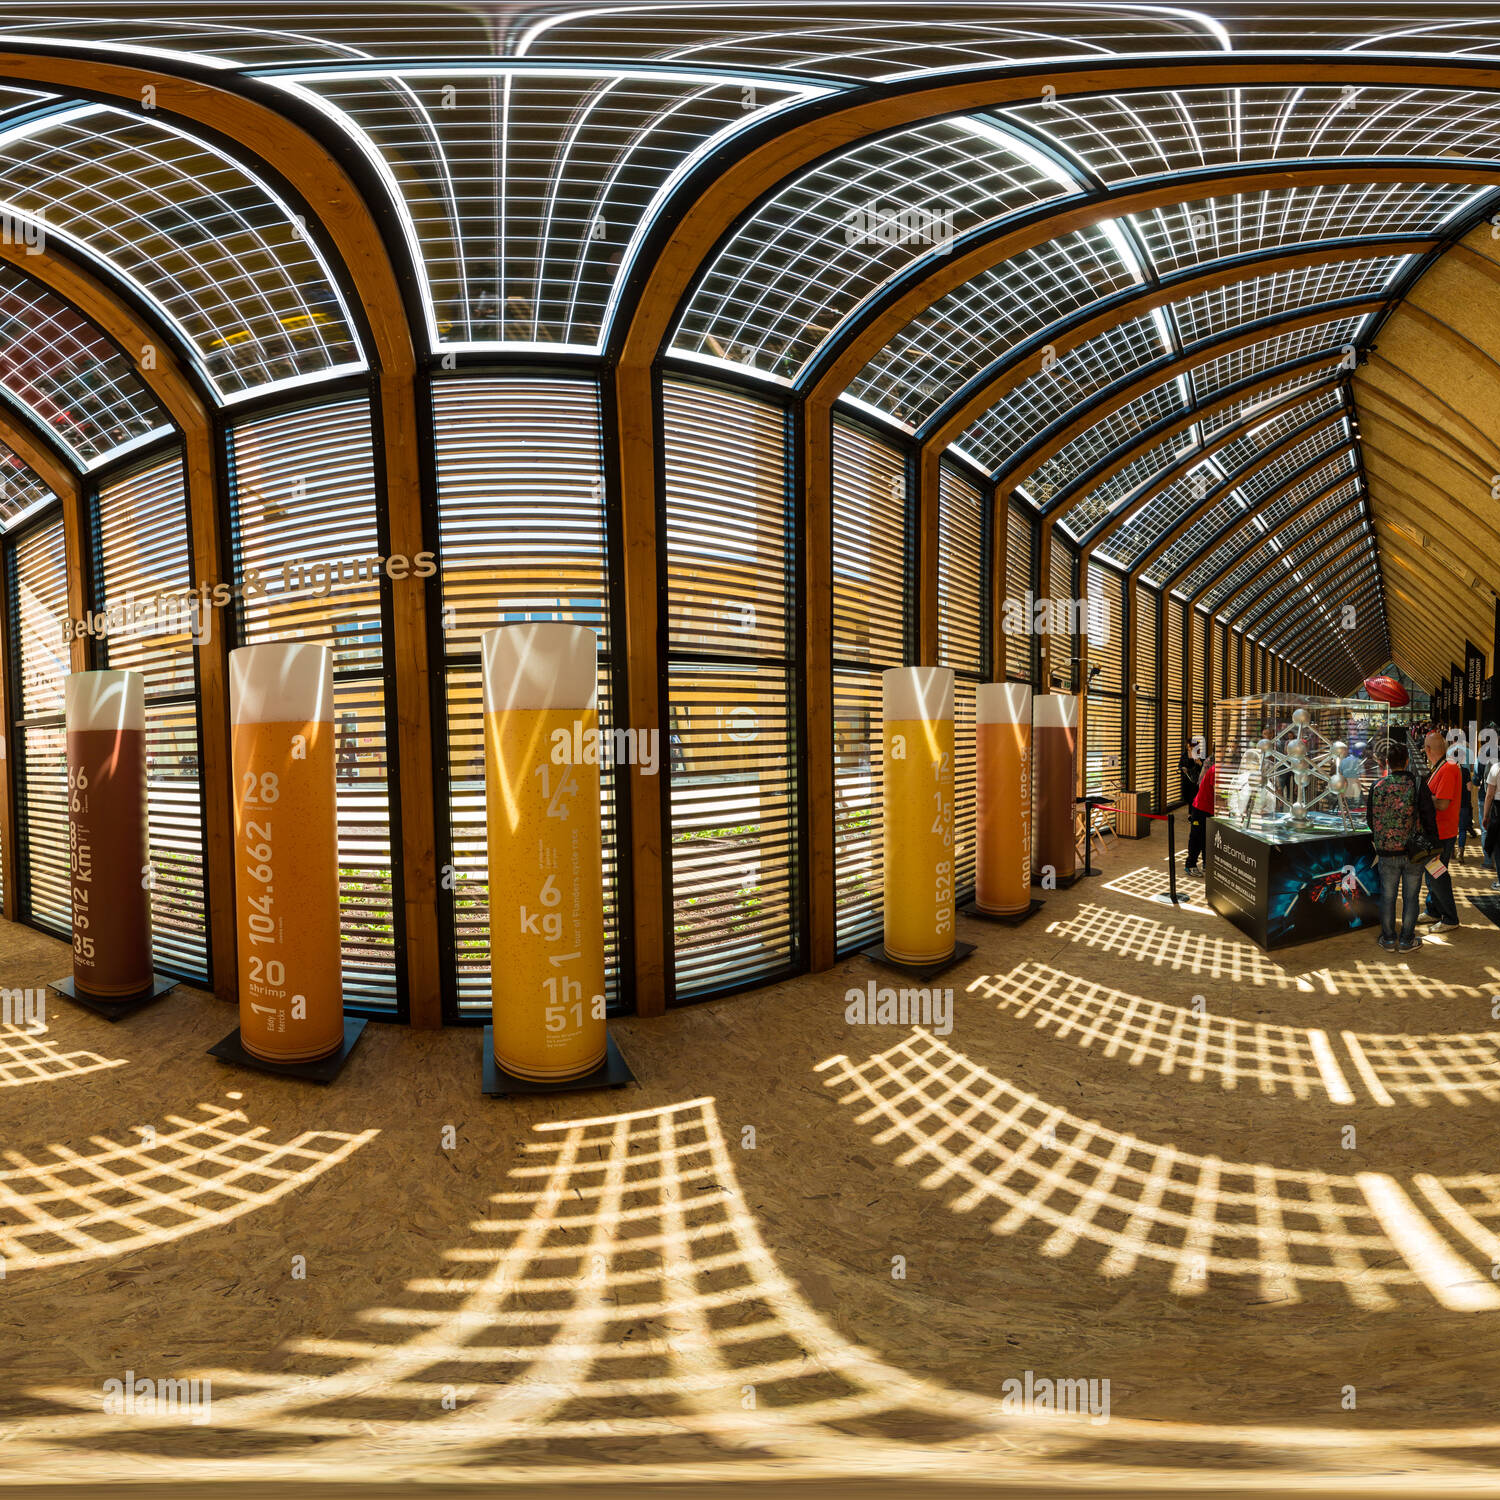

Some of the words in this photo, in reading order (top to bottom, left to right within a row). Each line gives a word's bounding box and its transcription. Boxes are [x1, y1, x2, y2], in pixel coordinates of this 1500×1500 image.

[241, 568, 267, 600] &
[281, 551, 437, 597] figures
[68, 766, 88, 790] 66
[243, 771, 280, 803] 28
[76, 845, 92, 882] km
[1222, 844, 1257, 869] atomium
[246, 821, 275, 946] 104.662
[540, 874, 561, 907] 6
[520, 905, 562, 941] kg
[73, 933, 95, 959] 35
[248, 956, 285, 986] 20
[249, 983, 286, 998] shrimp
[542, 976, 582, 1004] 1h
[545, 1002, 583, 1032] 51
